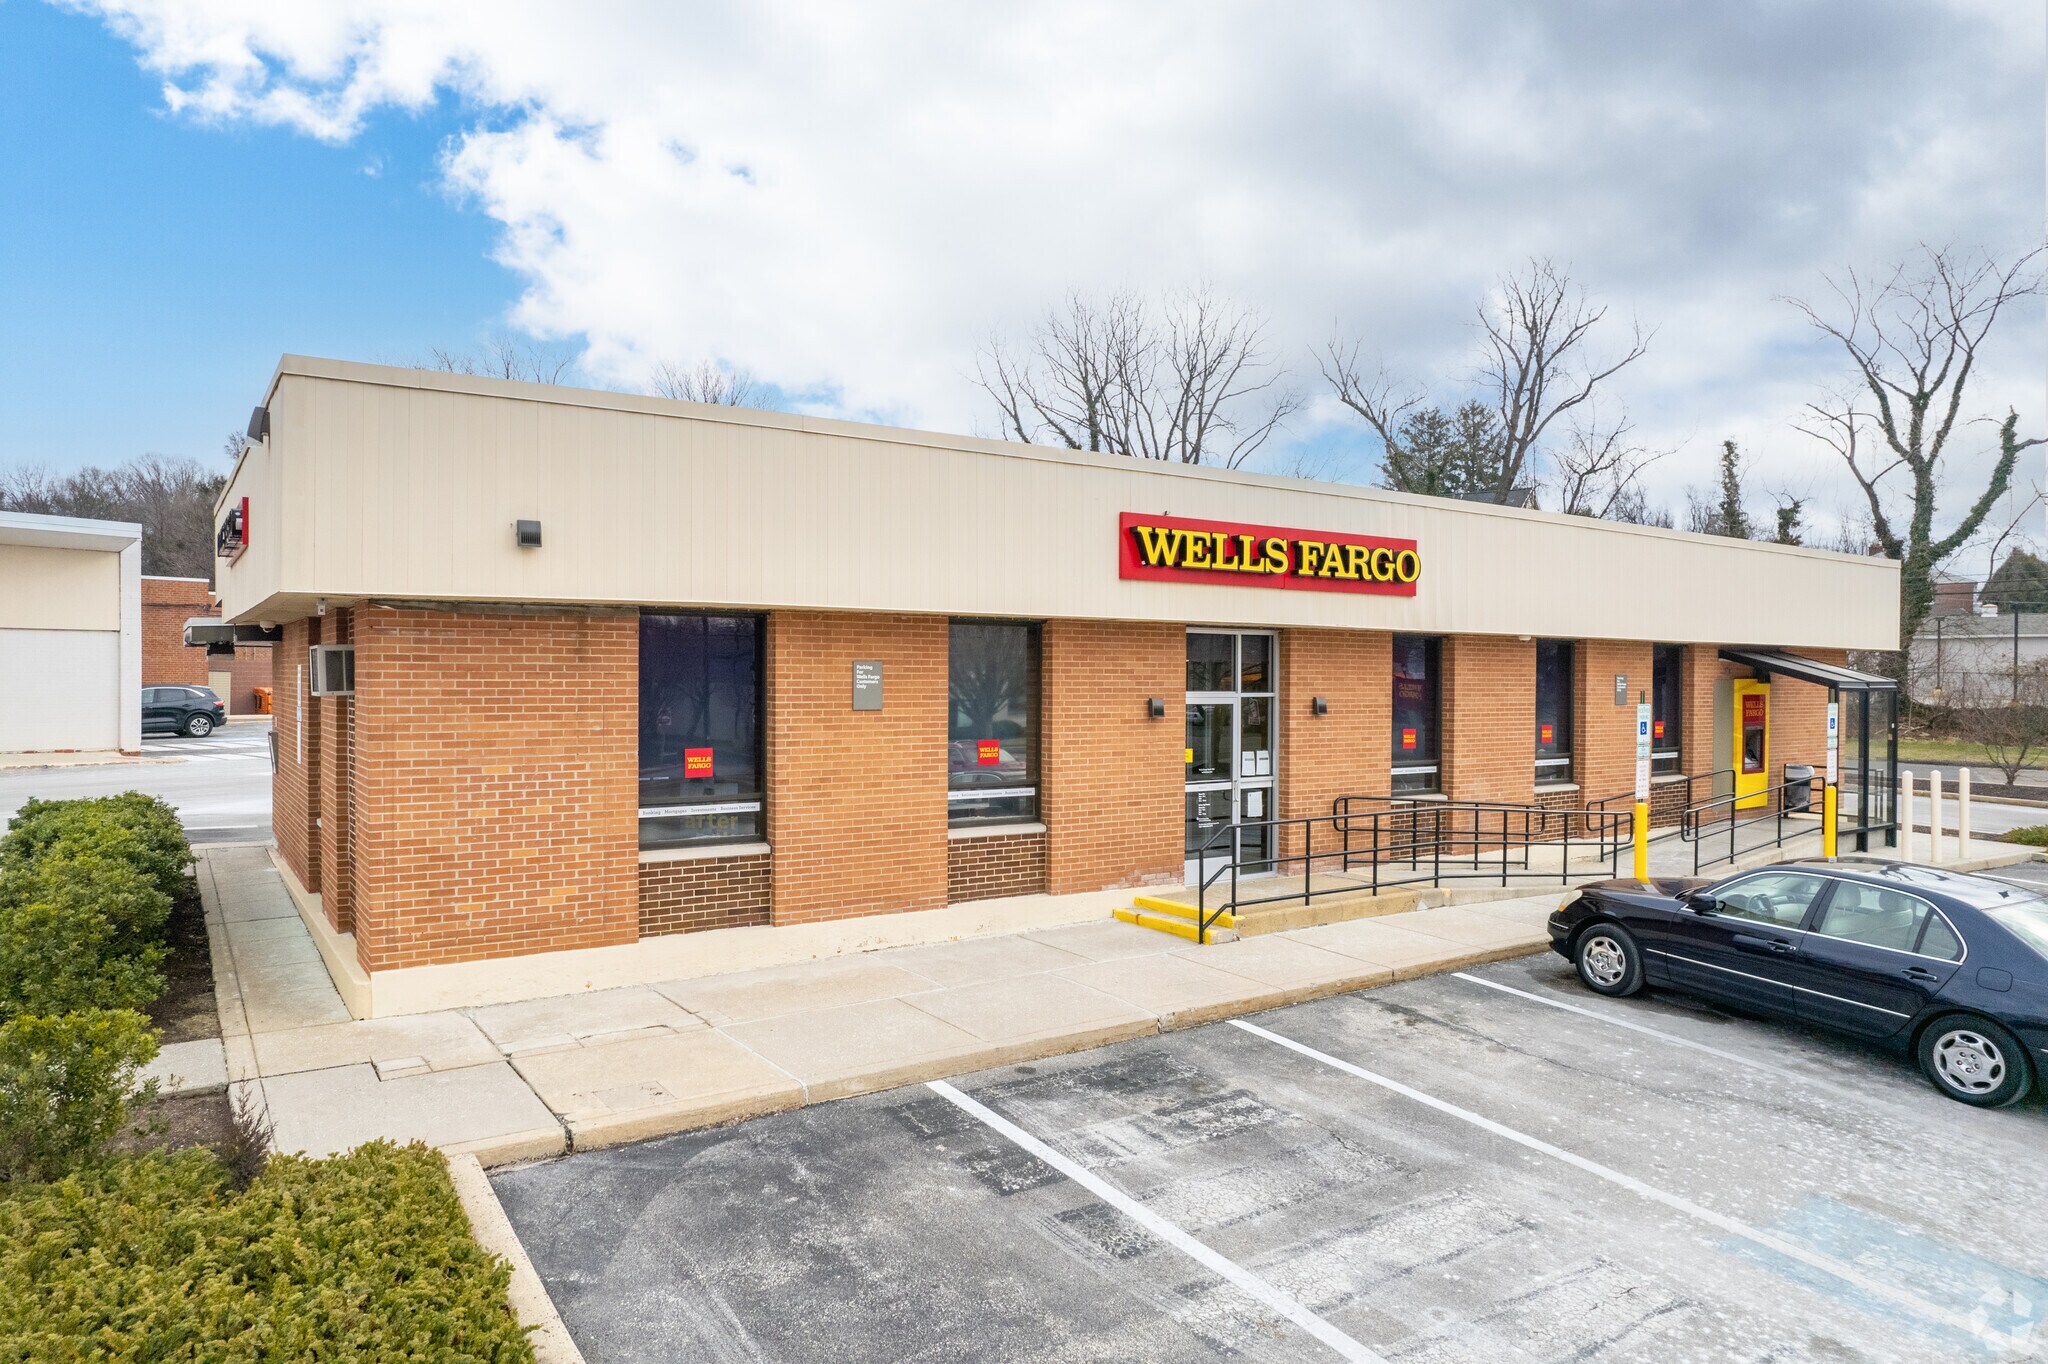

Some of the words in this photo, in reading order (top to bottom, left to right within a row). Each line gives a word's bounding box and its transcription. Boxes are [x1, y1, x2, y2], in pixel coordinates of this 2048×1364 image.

[1131, 525, 1289, 575] WELLS
[1294, 539, 1422, 584] FARGO
[1745, 700, 1764, 708] WELLS
